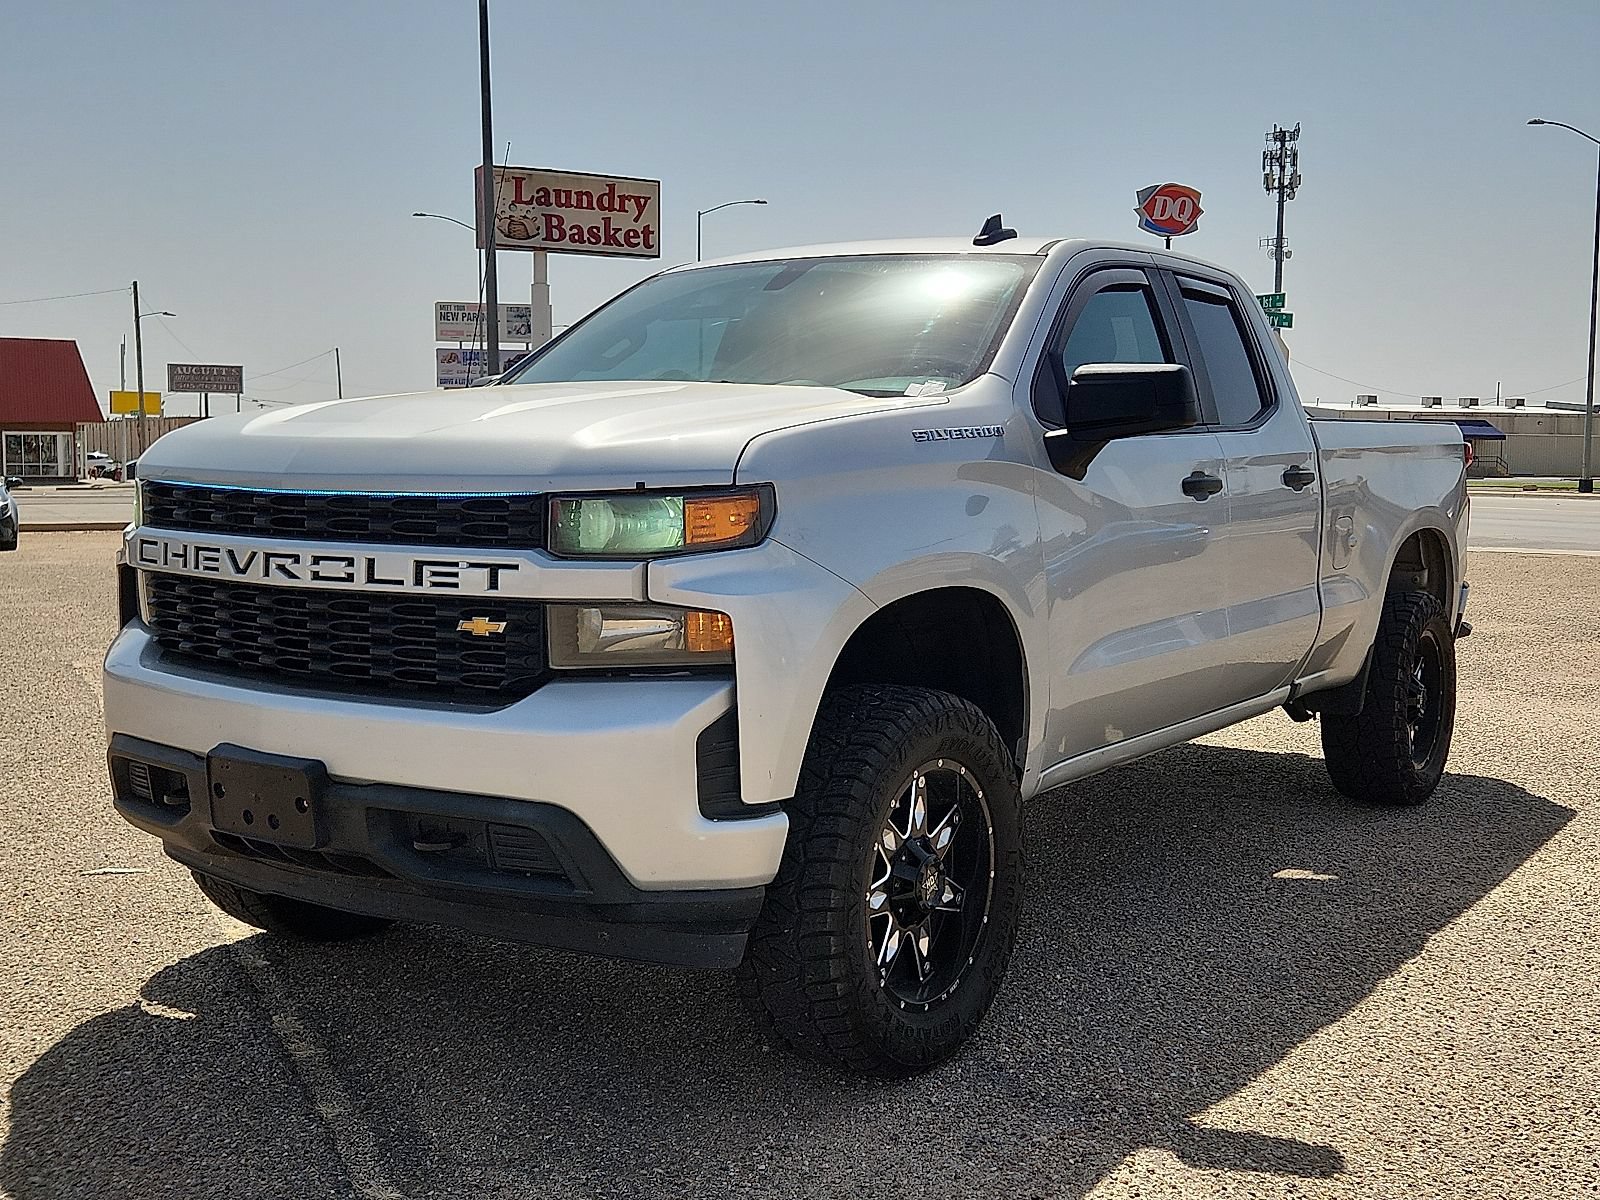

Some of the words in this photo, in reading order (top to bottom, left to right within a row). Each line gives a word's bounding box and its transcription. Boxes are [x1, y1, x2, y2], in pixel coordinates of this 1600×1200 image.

[512, 176, 652, 223] Laundry
[1152, 195, 1193, 225] DQ
[541, 213, 655, 249] Basket
[440, 312, 459, 322] NEW
[912, 424, 1006, 442] SILVERADO
[138, 538, 520, 592] CHEVROLET
